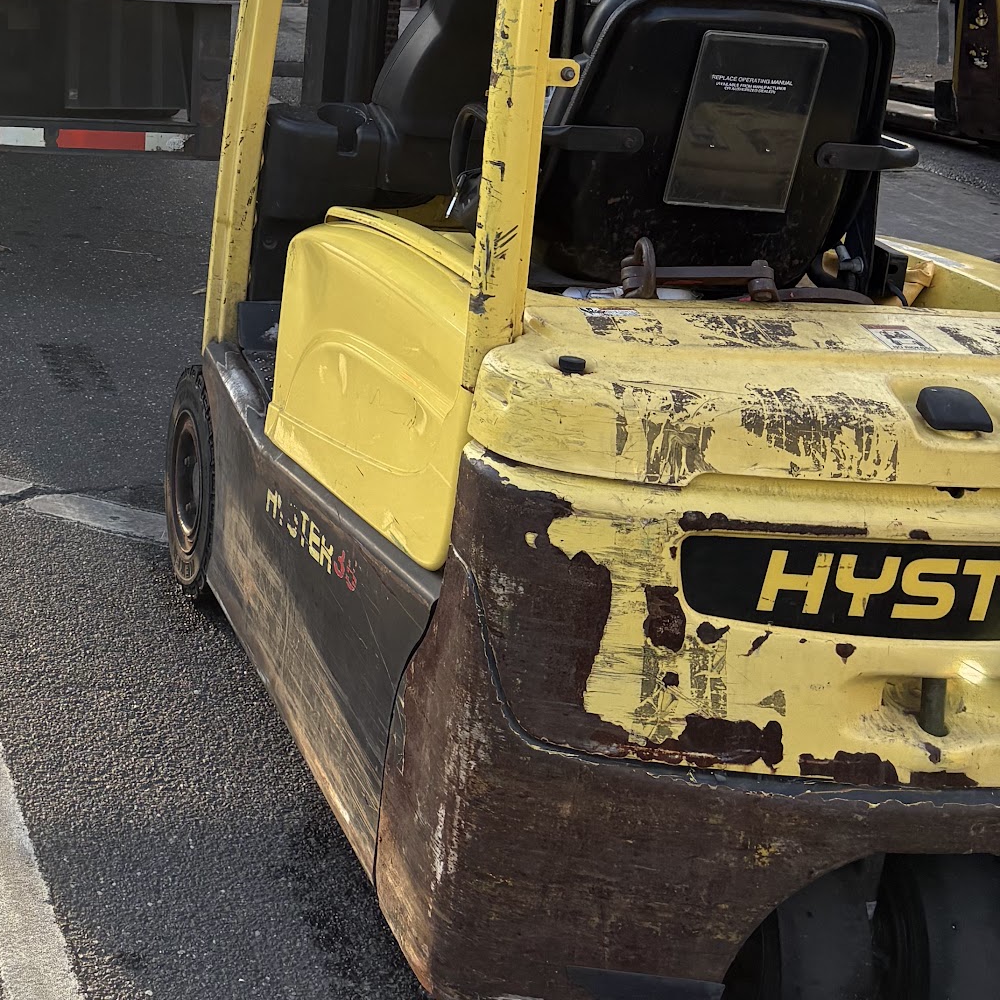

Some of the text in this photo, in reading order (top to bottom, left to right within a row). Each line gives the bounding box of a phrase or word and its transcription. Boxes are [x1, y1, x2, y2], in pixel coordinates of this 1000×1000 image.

[711, 74, 793, 87] REPLACE OPERATING MANUAL
[755, 549, 1000, 621] HYST
